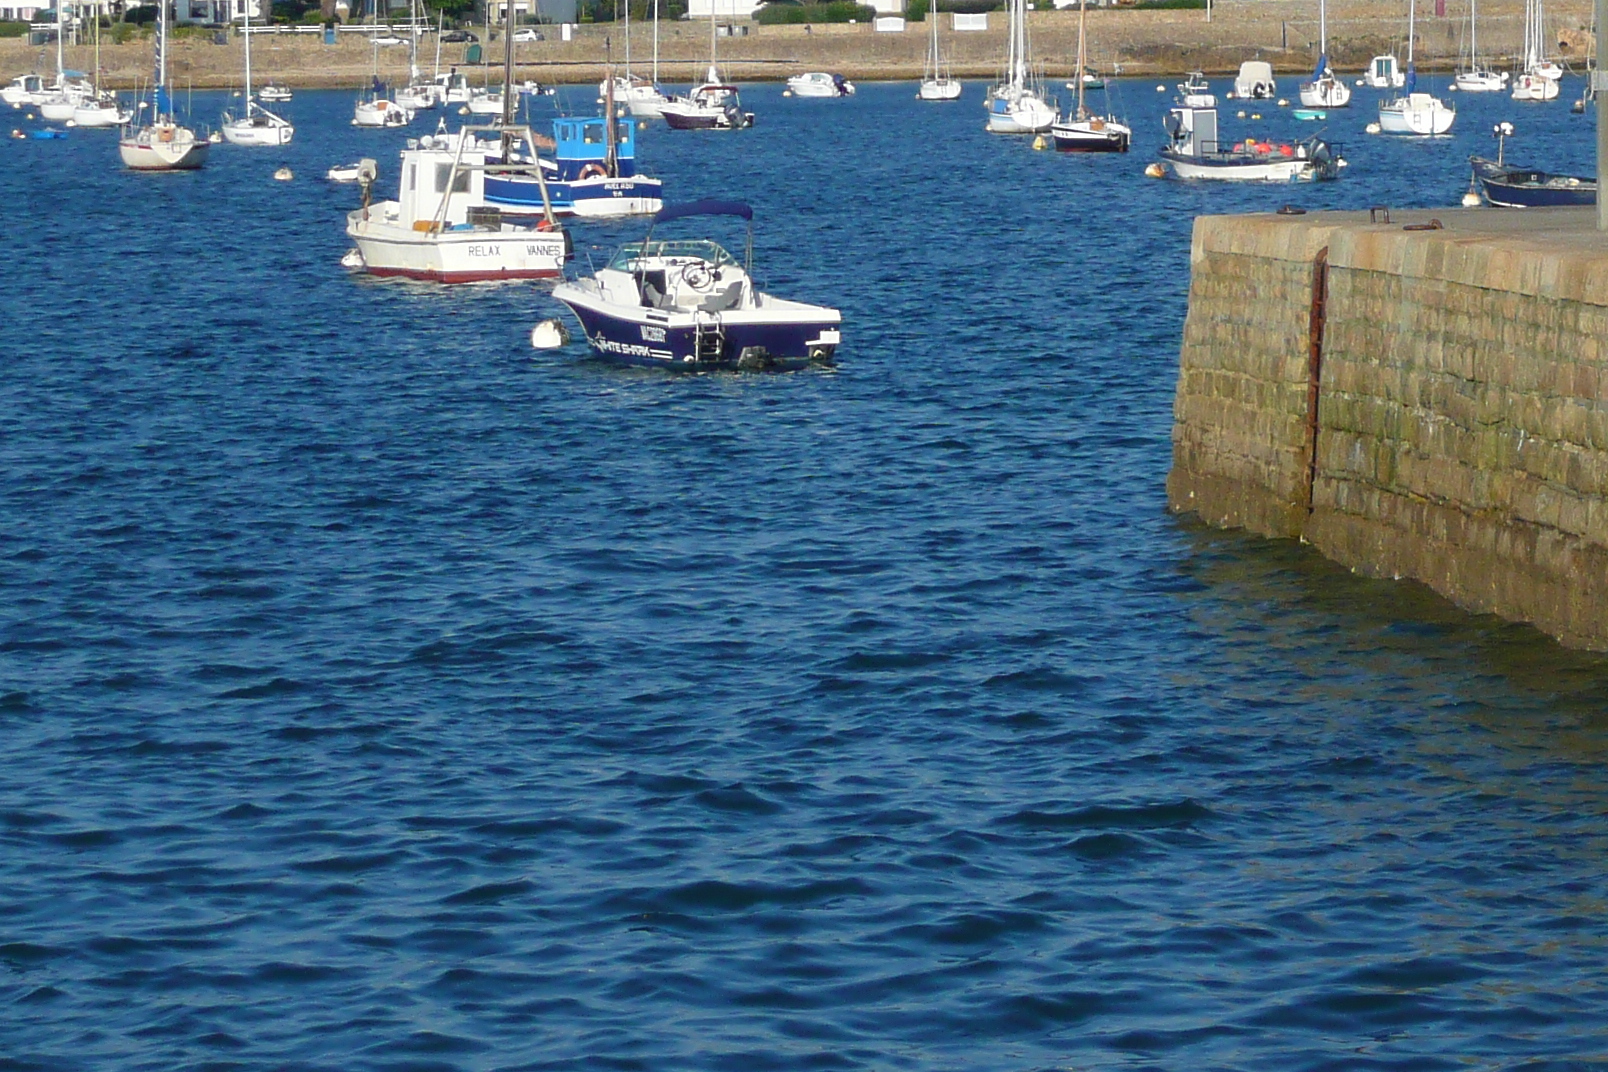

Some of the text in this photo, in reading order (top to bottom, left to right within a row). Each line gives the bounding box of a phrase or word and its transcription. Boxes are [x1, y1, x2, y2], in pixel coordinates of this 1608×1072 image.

[468, 245, 501, 257] RELAX
[526, 245, 561, 256] VANNES
[621, 343, 651, 357] SHARK
